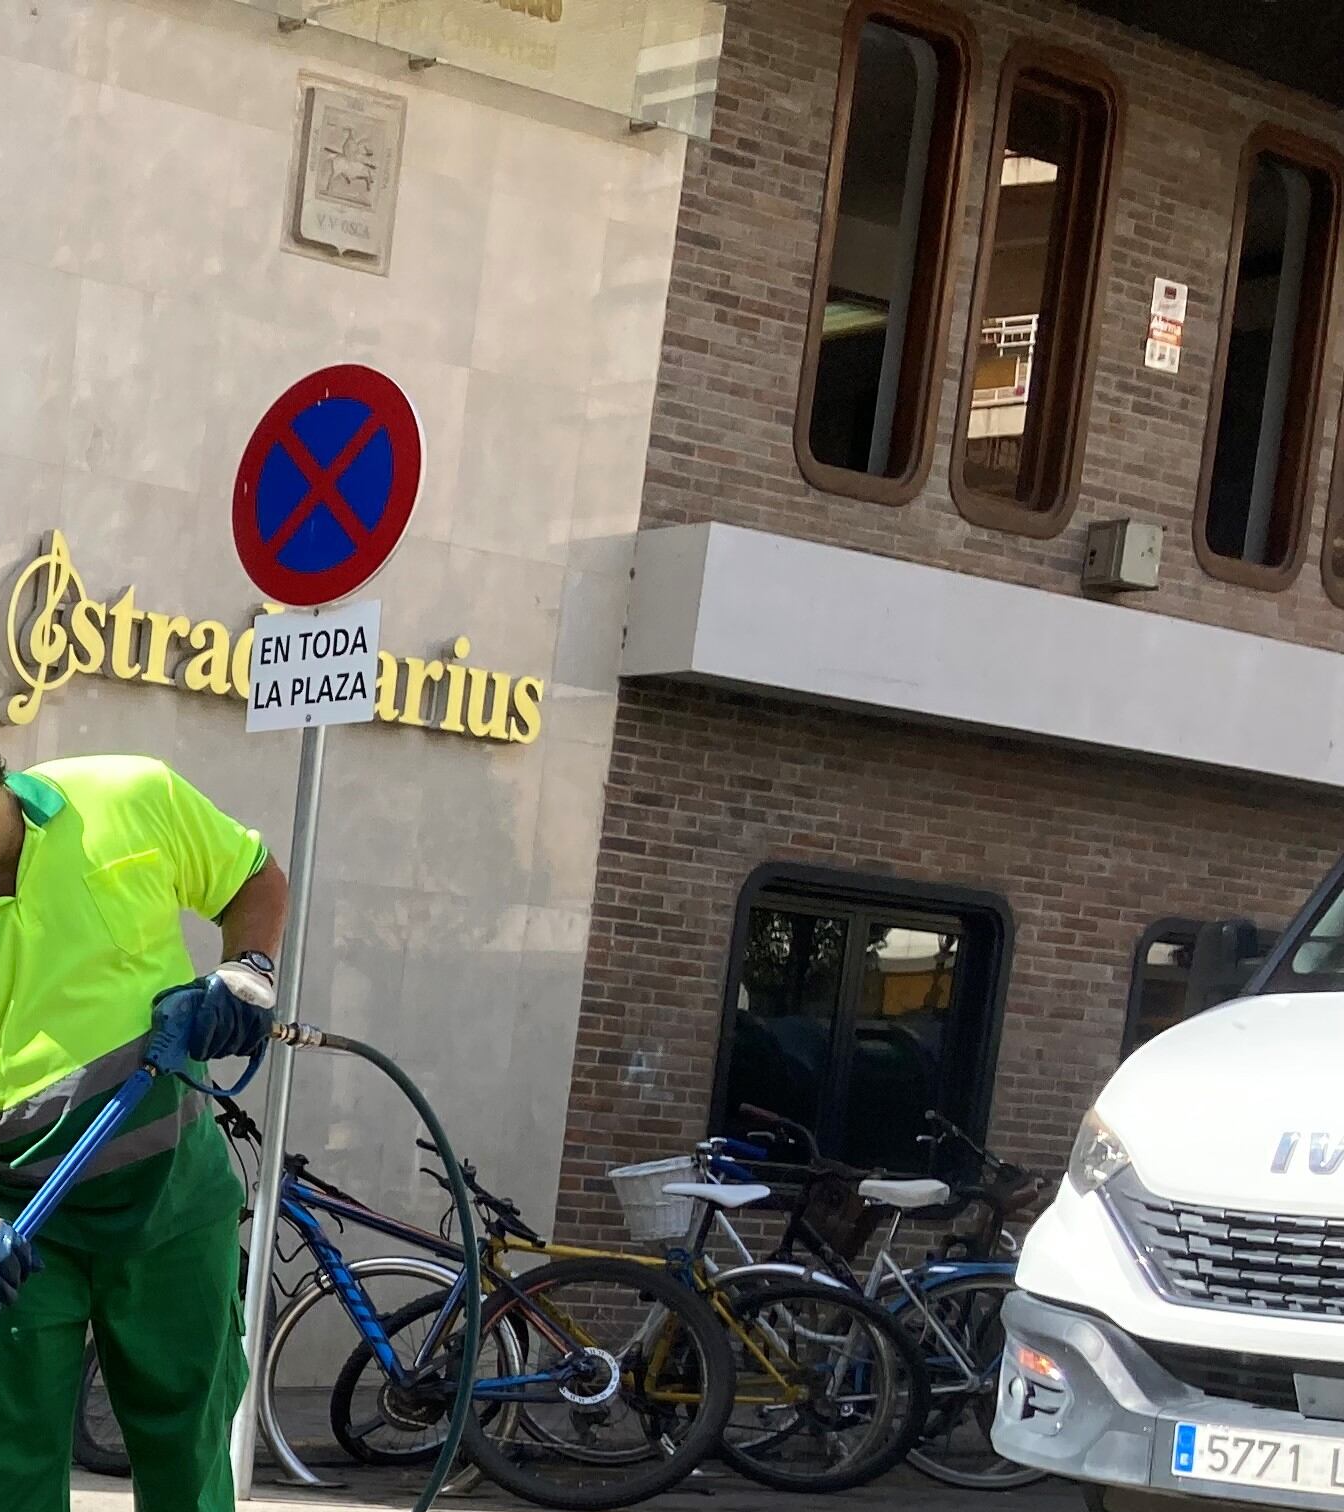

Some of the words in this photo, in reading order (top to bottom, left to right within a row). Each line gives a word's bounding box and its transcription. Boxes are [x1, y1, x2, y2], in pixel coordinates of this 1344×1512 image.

[260, 634, 291, 665] EN
[298, 626, 368, 661] TODA
[254, 680, 282, 709] LA
[290, 671, 367, 706] PLAZA
[1207, 1434, 1301, 1483] 5771
